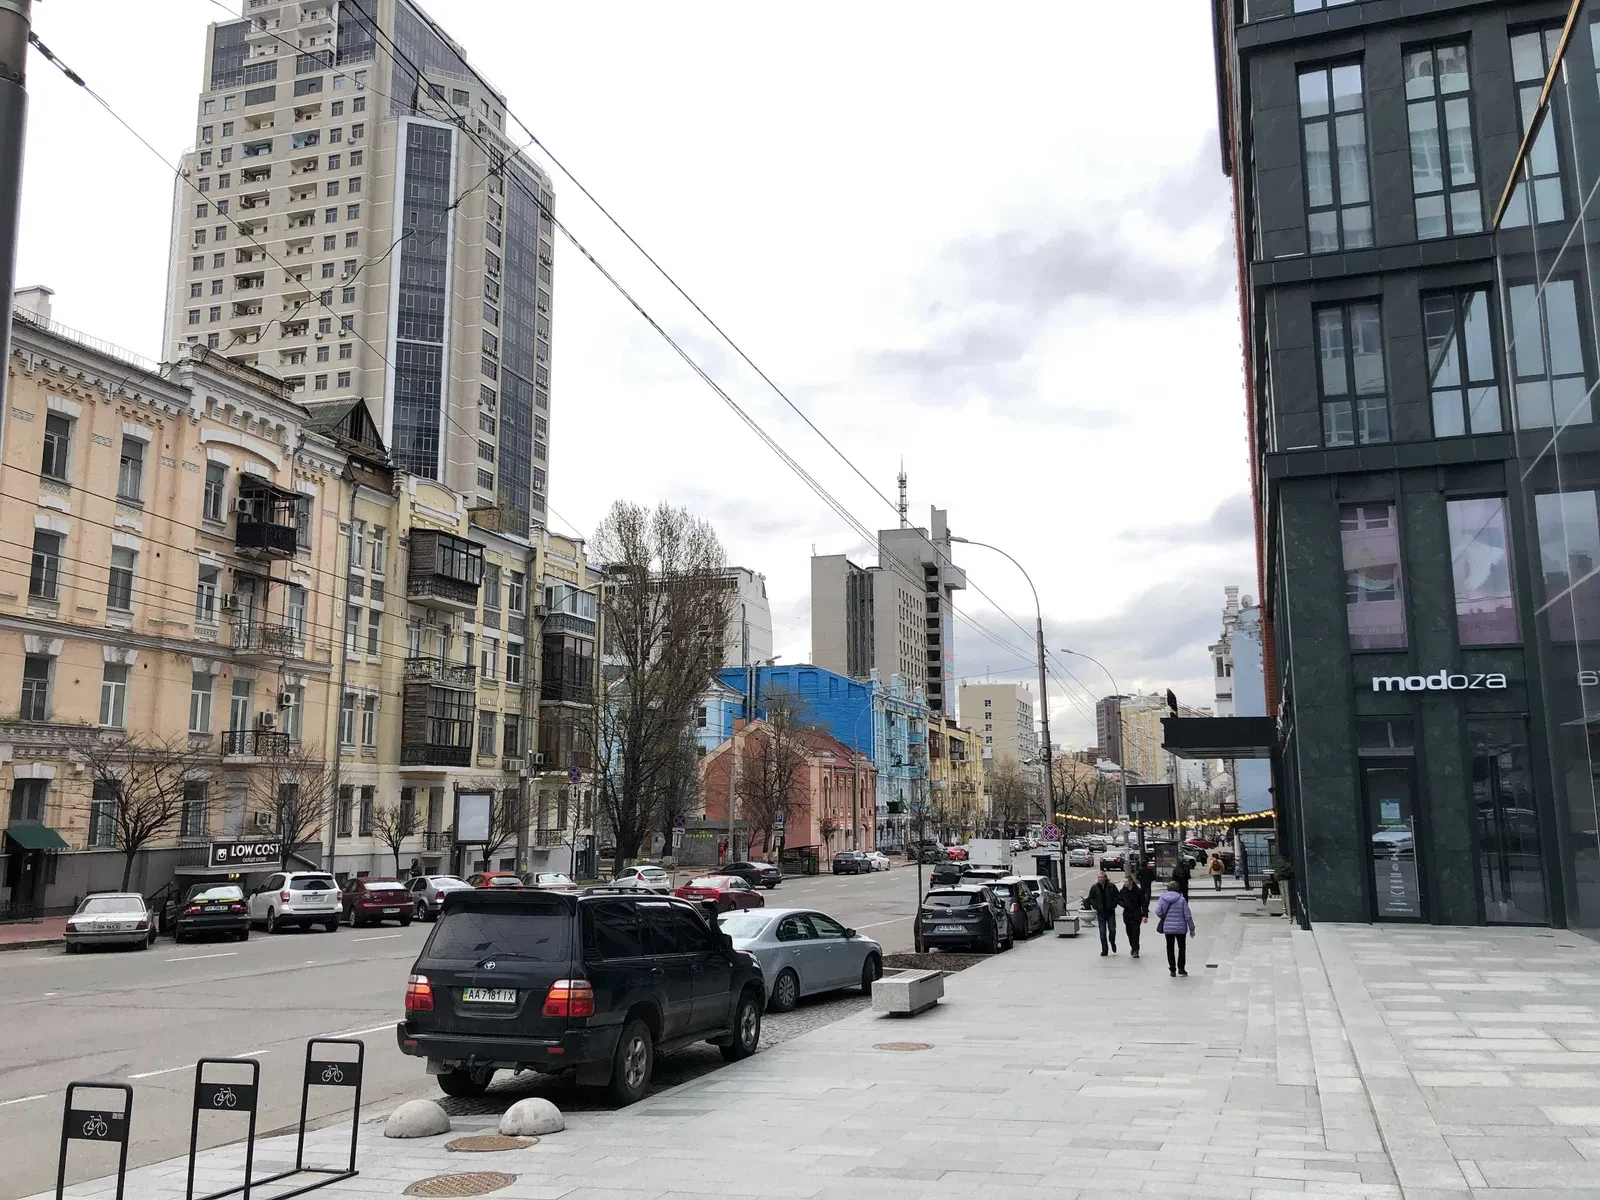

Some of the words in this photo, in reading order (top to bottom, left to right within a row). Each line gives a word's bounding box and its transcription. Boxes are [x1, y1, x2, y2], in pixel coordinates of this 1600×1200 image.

[1372, 670, 1507, 692] modoza
[231, 844, 254, 857] LOW
[255, 843, 280, 856] COST
